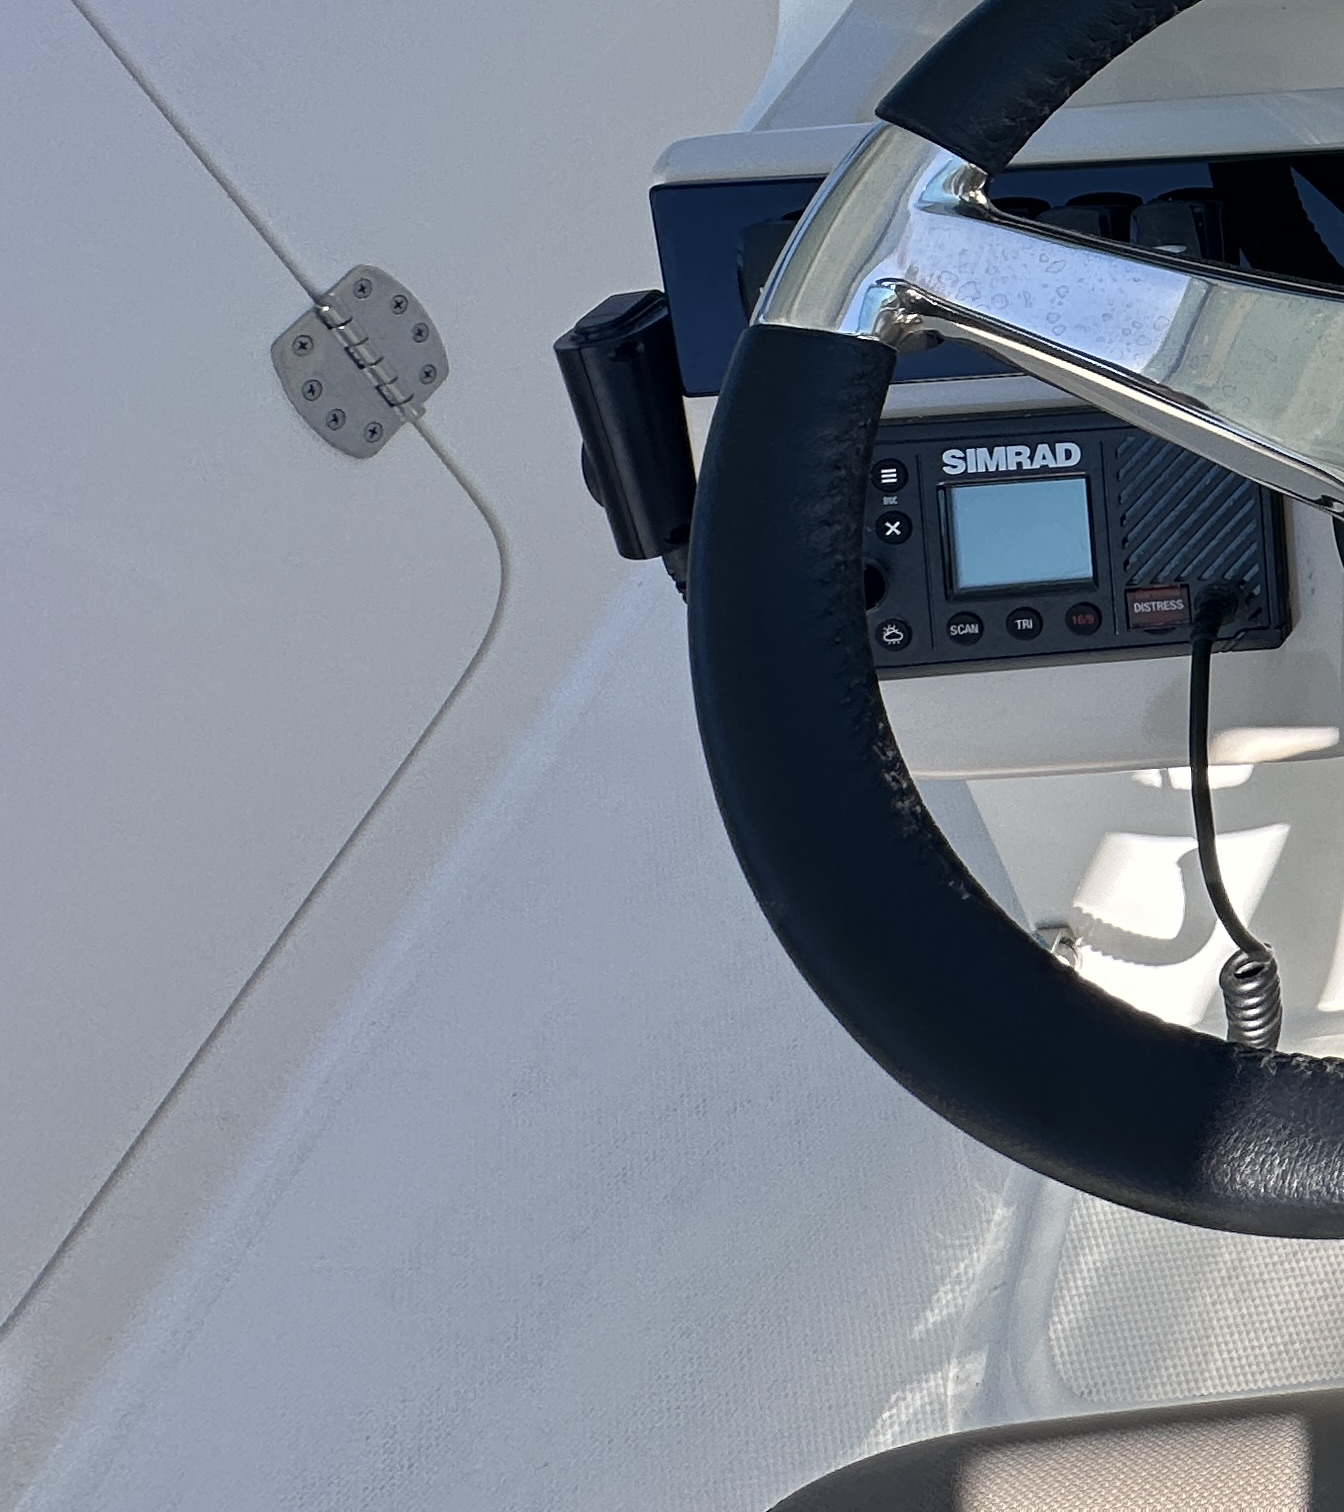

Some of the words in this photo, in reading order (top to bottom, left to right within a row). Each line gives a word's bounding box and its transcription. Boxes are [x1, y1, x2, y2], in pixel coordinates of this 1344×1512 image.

[942, 442, 1081, 475] SIMRAD
[1133, 599, 1185, 613] DISTRESS
[949, 621, 980, 636] SCAN
[1014, 618, 1033, 630] TRI
[1071, 614, 1095, 625] 16/9
